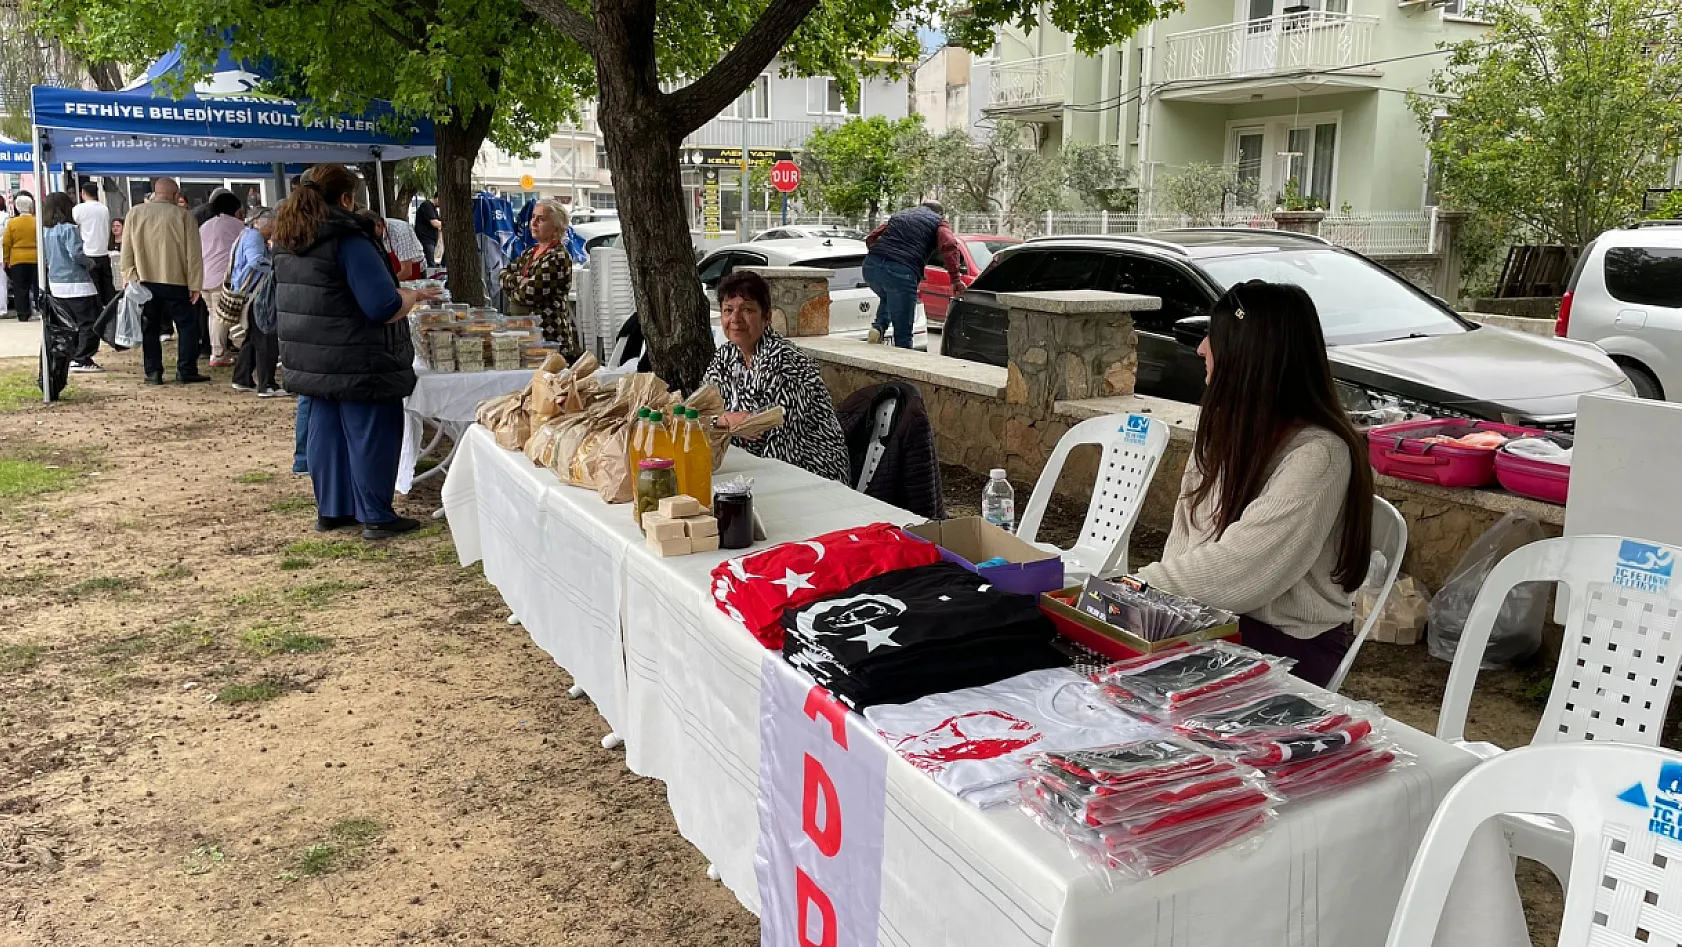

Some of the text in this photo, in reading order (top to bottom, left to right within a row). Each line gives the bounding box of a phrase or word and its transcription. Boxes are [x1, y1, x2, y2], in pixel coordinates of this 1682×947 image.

[64, 102, 145, 118] FETHİYE
[150, 105, 252, 124] BELEDİYESİ
[257, 111, 325, 129] KÜLTR
[15, 150, 35, 162] MÜ
[772, 170, 798, 183] DUR
